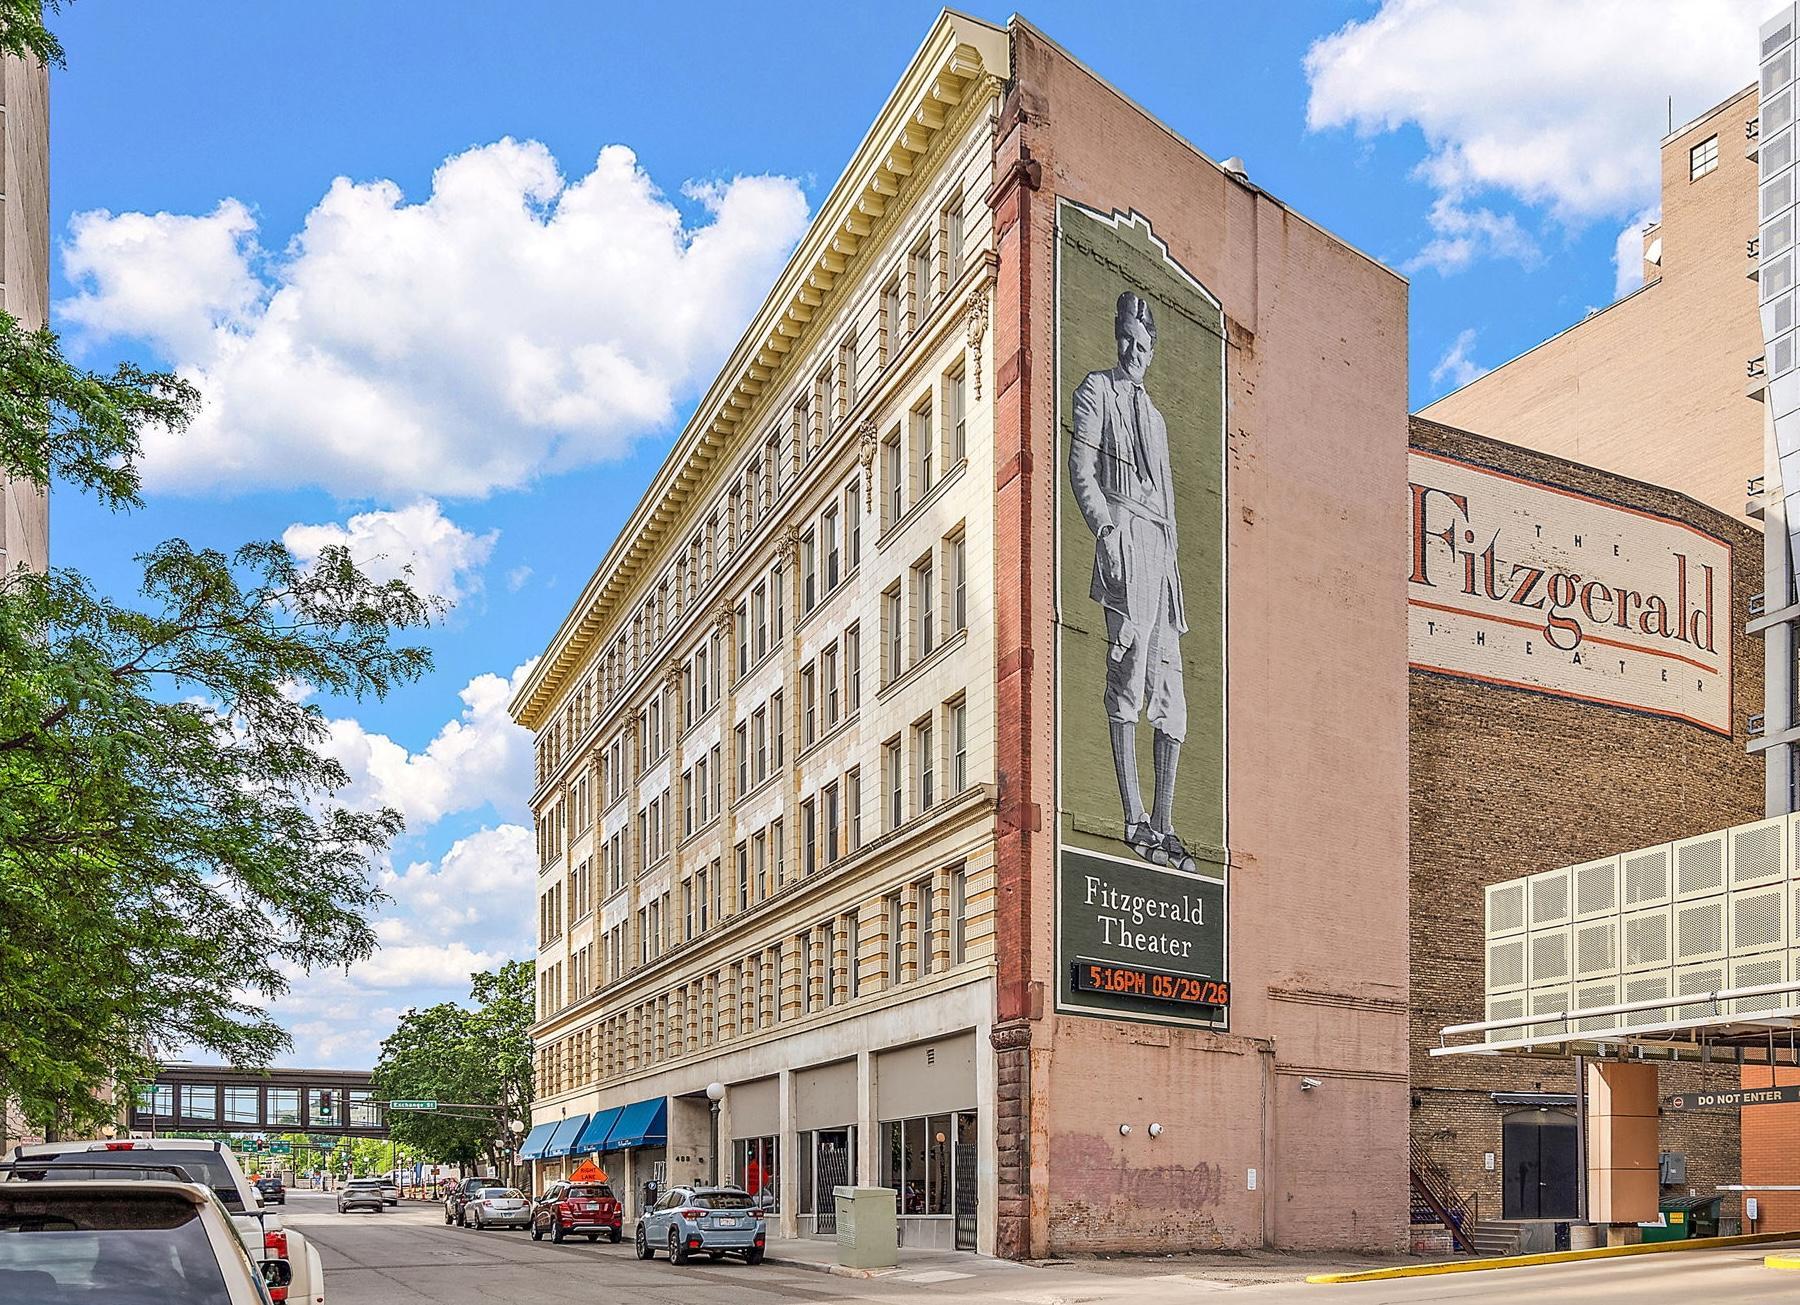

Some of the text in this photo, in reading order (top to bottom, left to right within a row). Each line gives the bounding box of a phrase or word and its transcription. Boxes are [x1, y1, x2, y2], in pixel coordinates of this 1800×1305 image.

[1535, 524, 1620, 558] THE
[1408, 481, 1718, 655] Fitzgerald
[1428, 621, 1703, 693] THEATER
[1084, 875, 1205, 926] Fitzgerald
[1097, 915, 1193, 958] Theater
[1152, 974, 1229, 1004] 05/29/26
[1698, 1090, 1782, 1106] DO NOT ENTER
